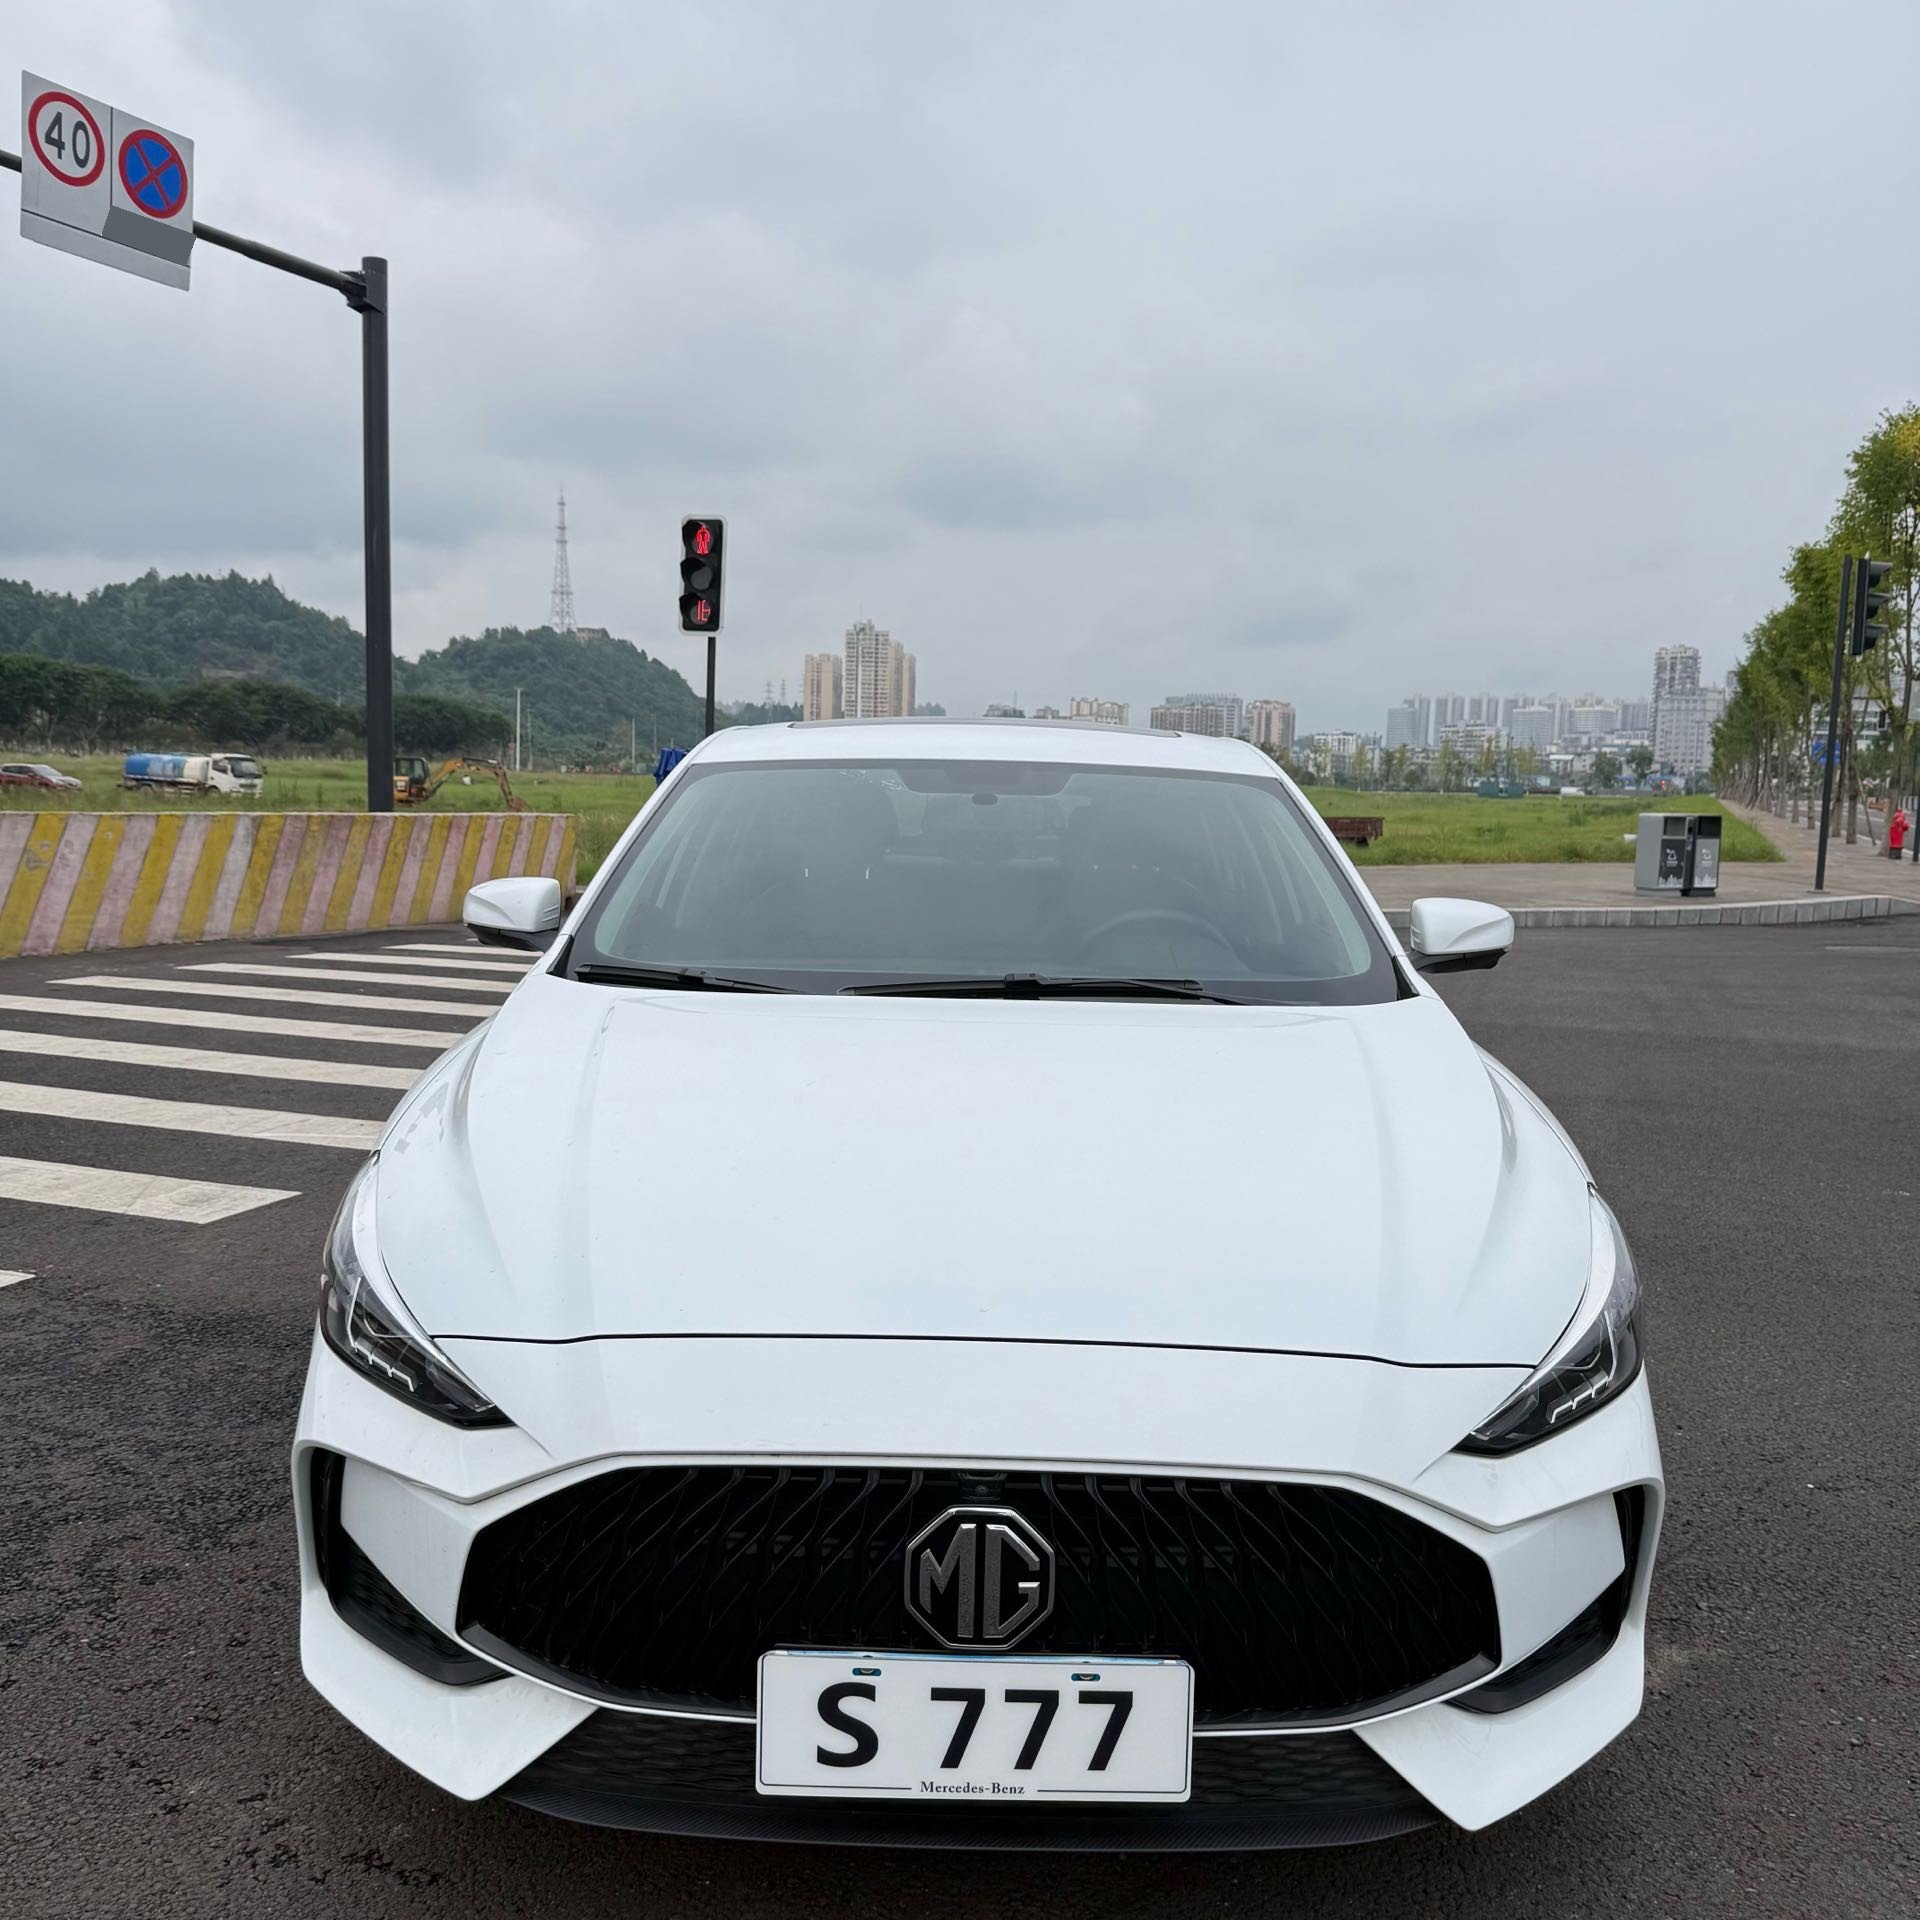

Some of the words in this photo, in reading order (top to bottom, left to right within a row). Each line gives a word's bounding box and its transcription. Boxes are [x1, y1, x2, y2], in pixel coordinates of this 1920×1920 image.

[44, 111, 90, 169] 40
[919, 1523, 1041, 1638] MG
[816, 1681, 879, 1768] S
[930, 1687, 1134, 1771] 777
[920, 1781, 1026, 1795] Mercedes-Benz
